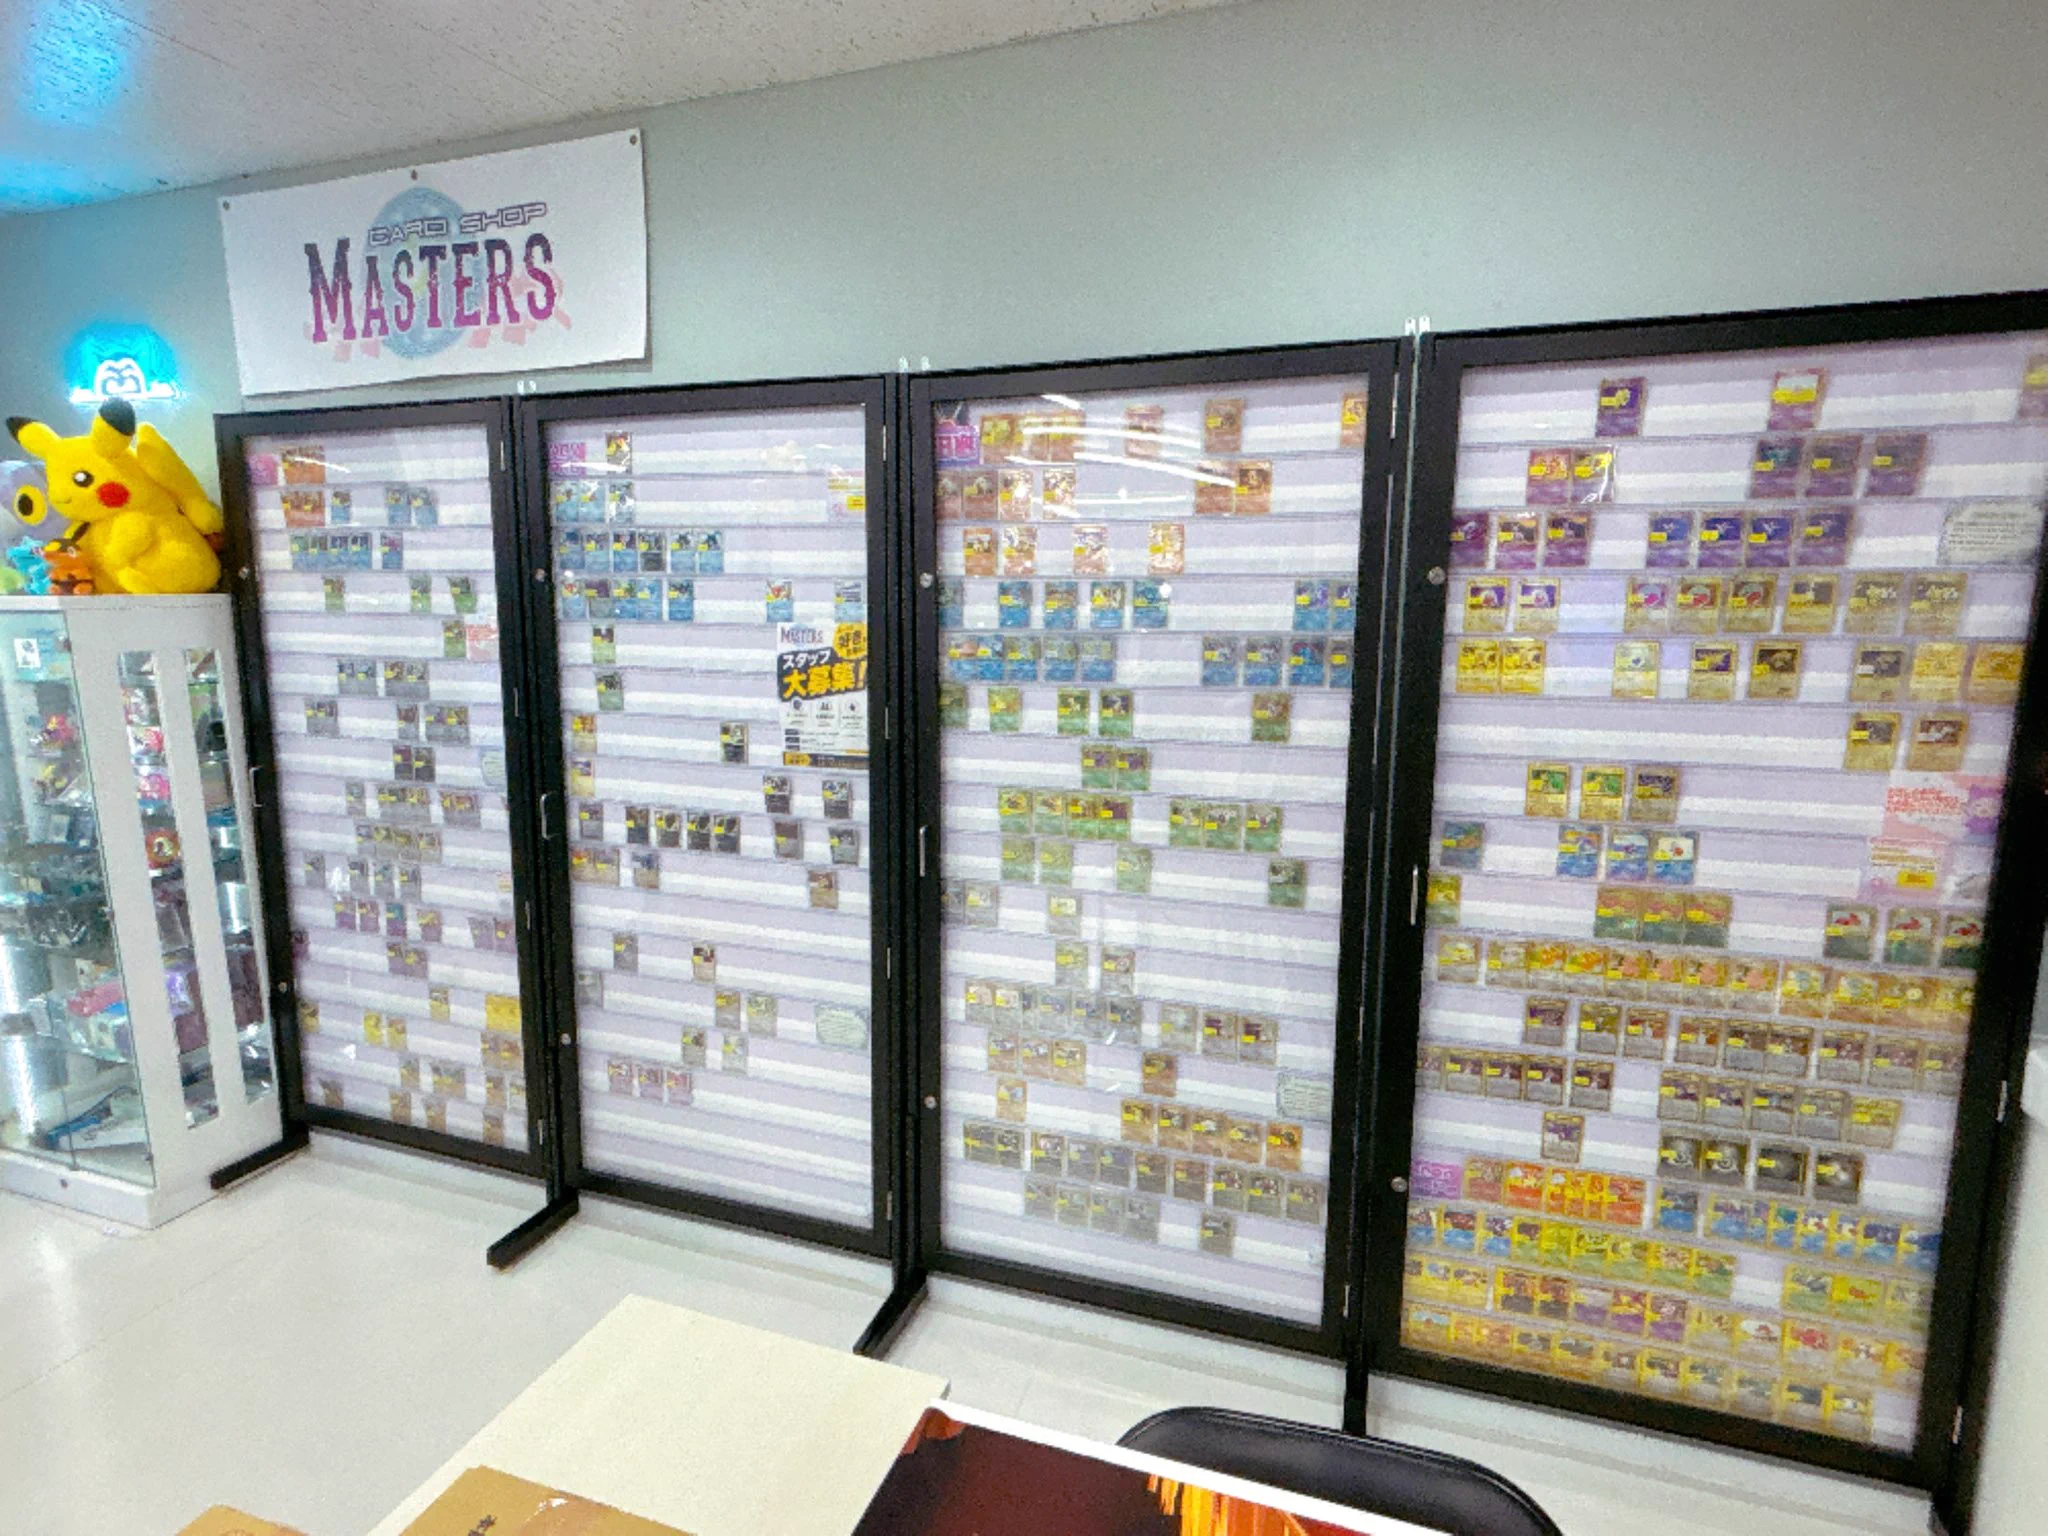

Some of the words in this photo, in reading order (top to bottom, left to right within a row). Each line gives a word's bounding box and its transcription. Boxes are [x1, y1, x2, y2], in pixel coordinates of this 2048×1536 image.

[368, 216, 449, 247] CARD
[460, 202, 548, 234] SHOP
[304, 233, 557, 343] MASTERS
[782, 649, 831, 670] スタッフ
